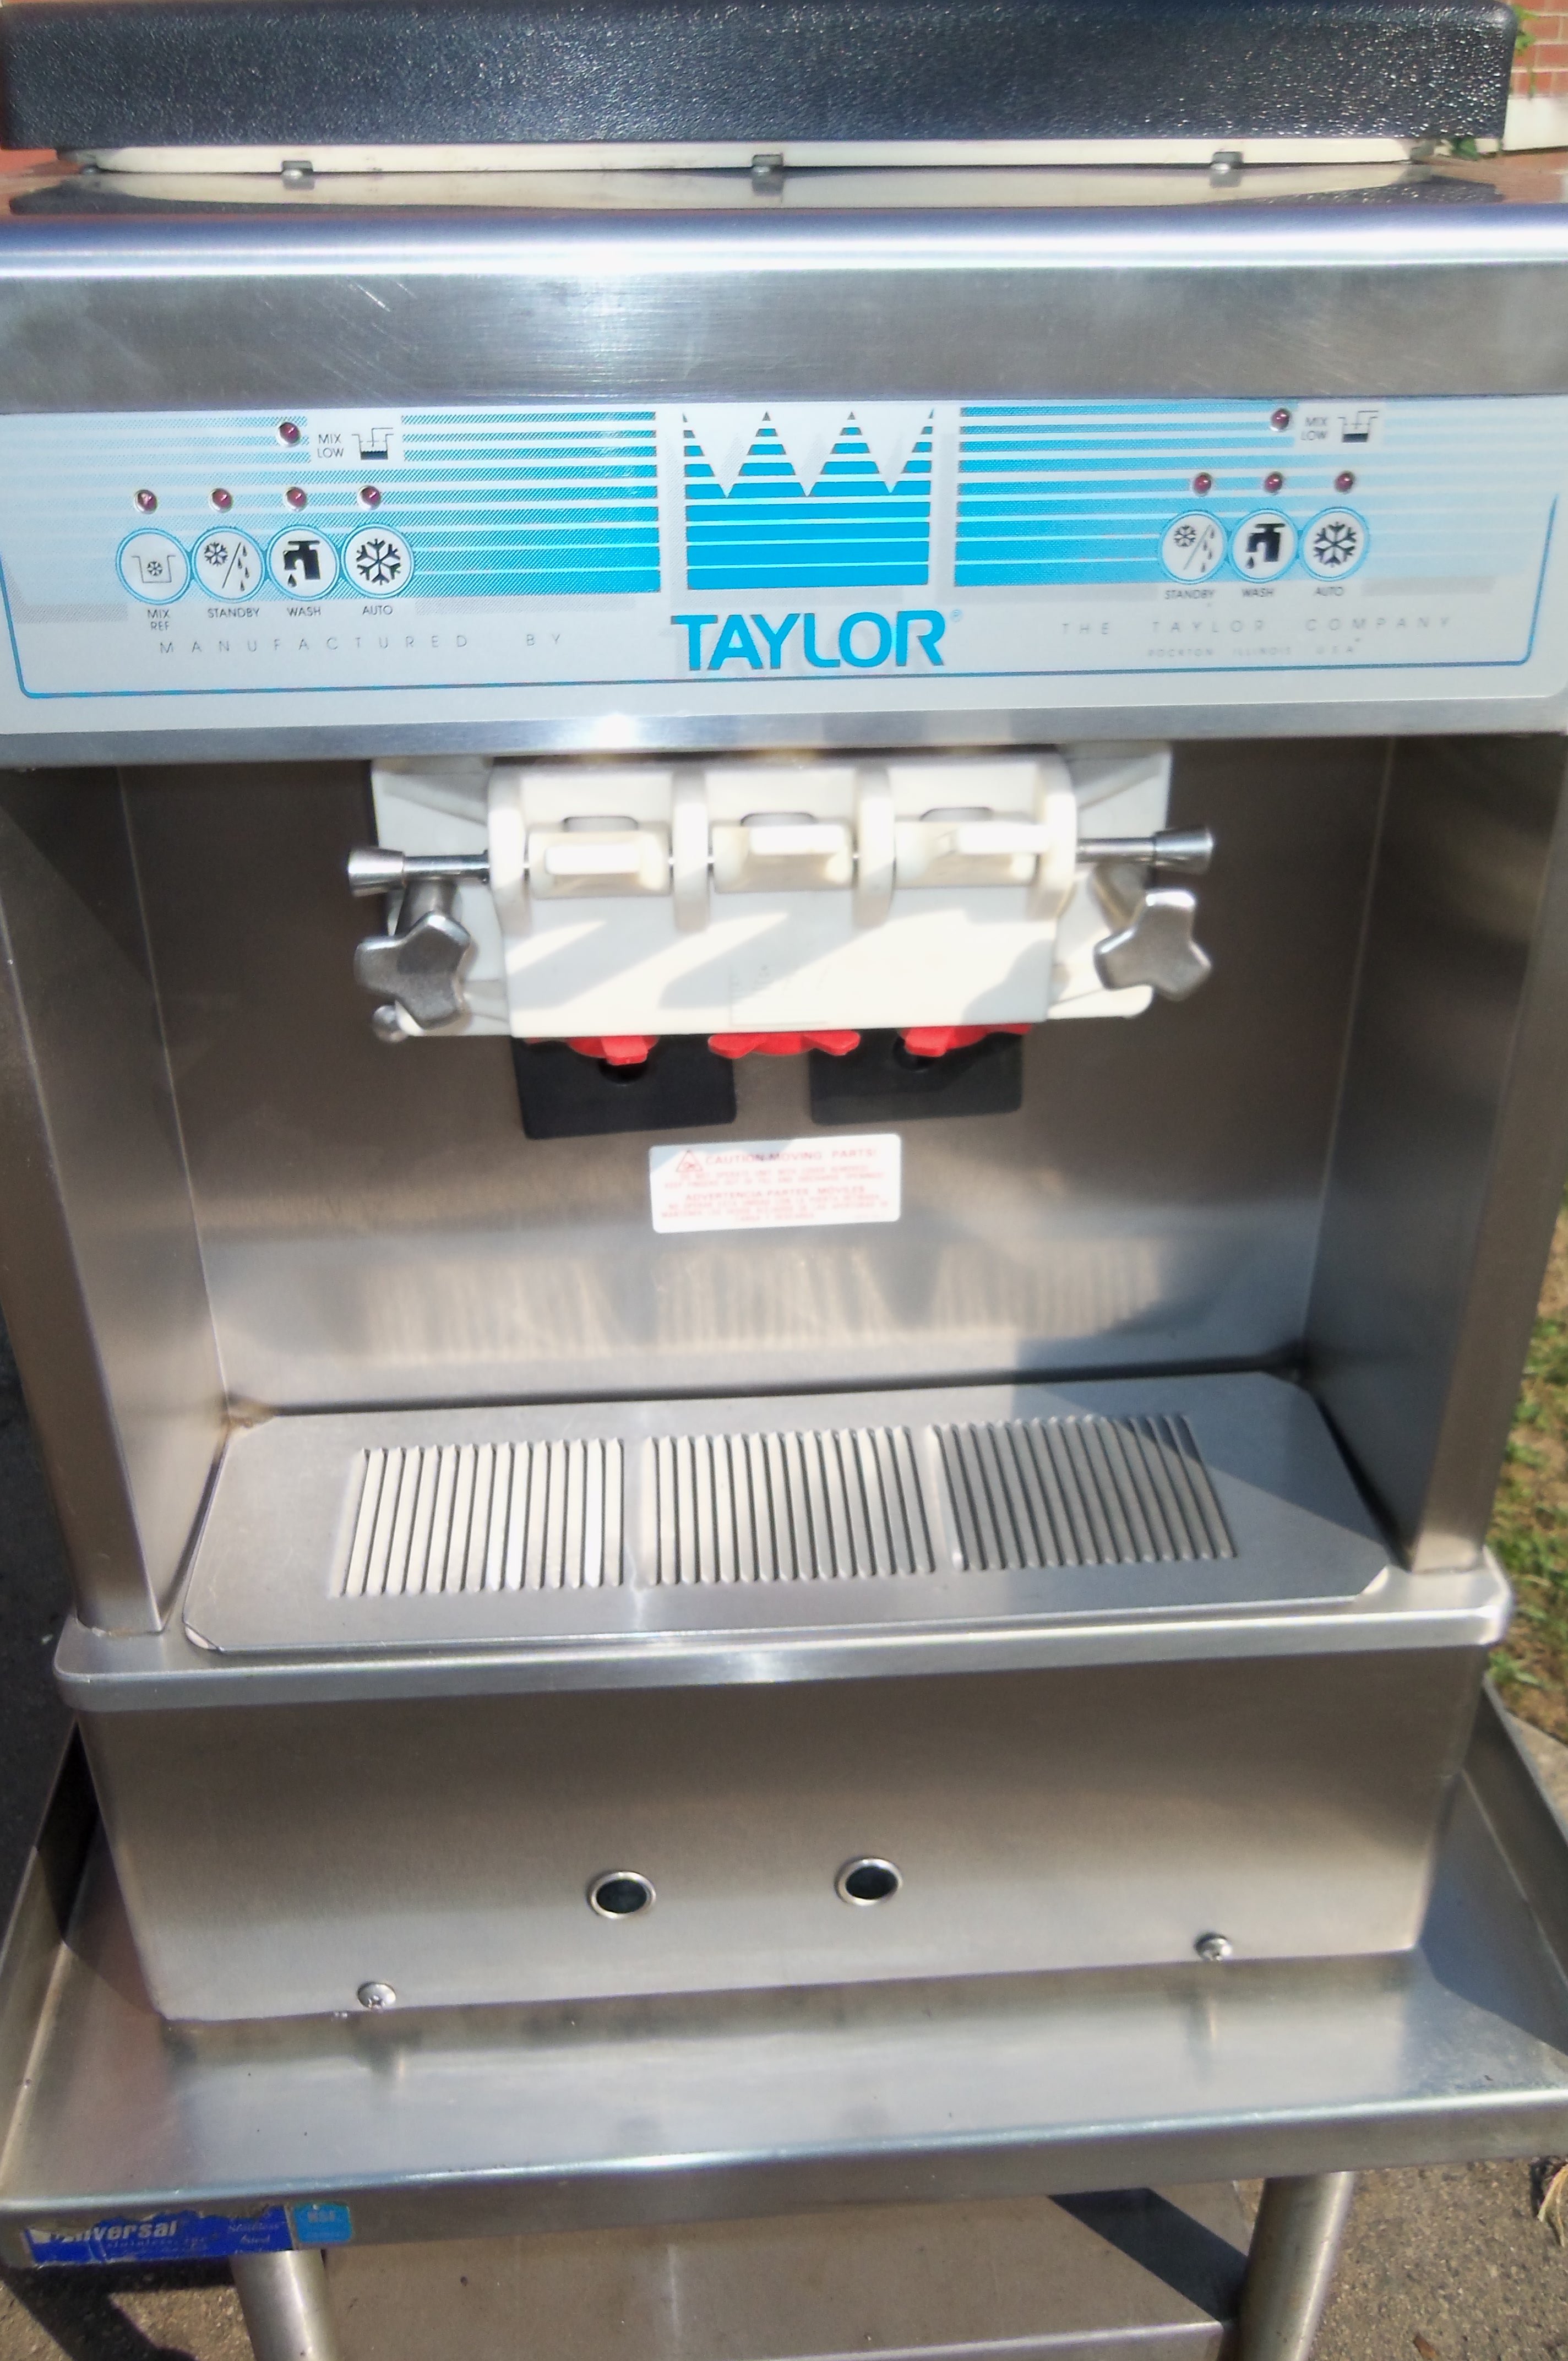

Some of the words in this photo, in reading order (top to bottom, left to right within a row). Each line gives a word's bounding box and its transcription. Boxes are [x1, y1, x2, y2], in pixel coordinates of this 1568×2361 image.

[318, 434, 342, 444] MIX
[1301, 430, 1327, 440] LOW
[317, 448, 344, 458] LOW
[1164, 589, 1215, 600] STANDBY
[1242, 587, 1275, 598] WASH
[1315, 586, 1344, 596] AUTO
[147, 609, 170, 619] MIX
[207, 607, 260, 618] STANDBY
[286, 606, 322, 617] WASH
[362, 605, 393, 616] AUTO
[150, 621, 170, 631] REF
[1062, 623, 1109, 635] THE
[1153, 620, 1264, 634] TAYLOR
[1305, 617, 1450, 631] COMPANY
[160, 634, 467, 654] MANUFACTURED
[526, 633, 561, 647] BY
[671, 610, 945, 671] TAYLOR
